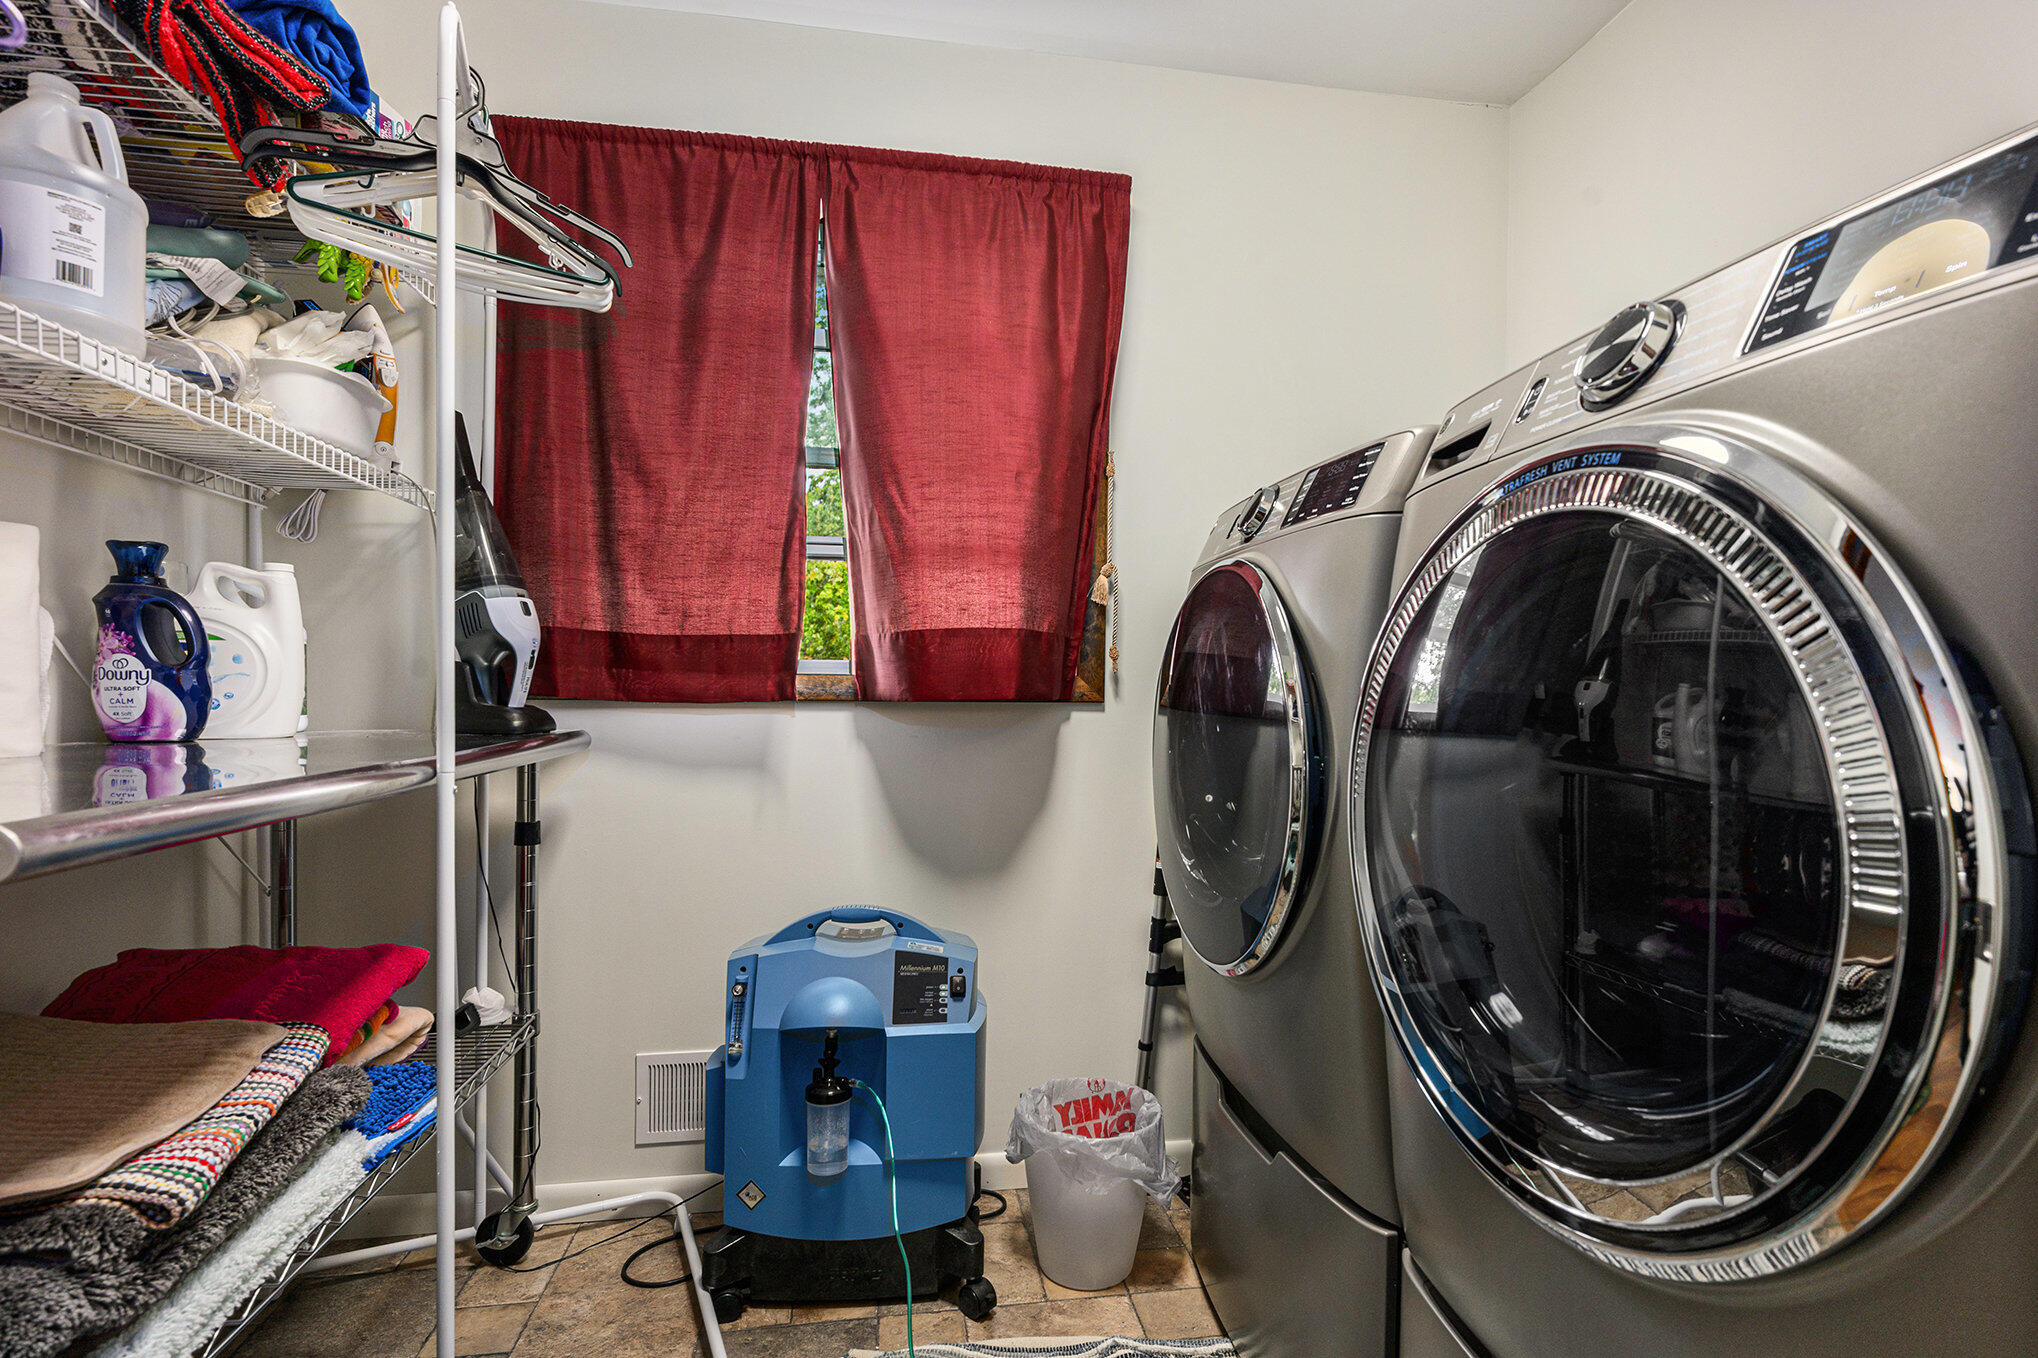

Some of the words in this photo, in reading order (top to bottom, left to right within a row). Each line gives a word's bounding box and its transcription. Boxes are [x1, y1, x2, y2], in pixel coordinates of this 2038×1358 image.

[1945, 261, 1968, 273] Spin
[1874, 285, 1897, 298] Temp
[1552, 456, 1579, 471] VENT
[1580, 452, 1622, 467] SYSTEM
[98, 666, 150, 686] Downy
